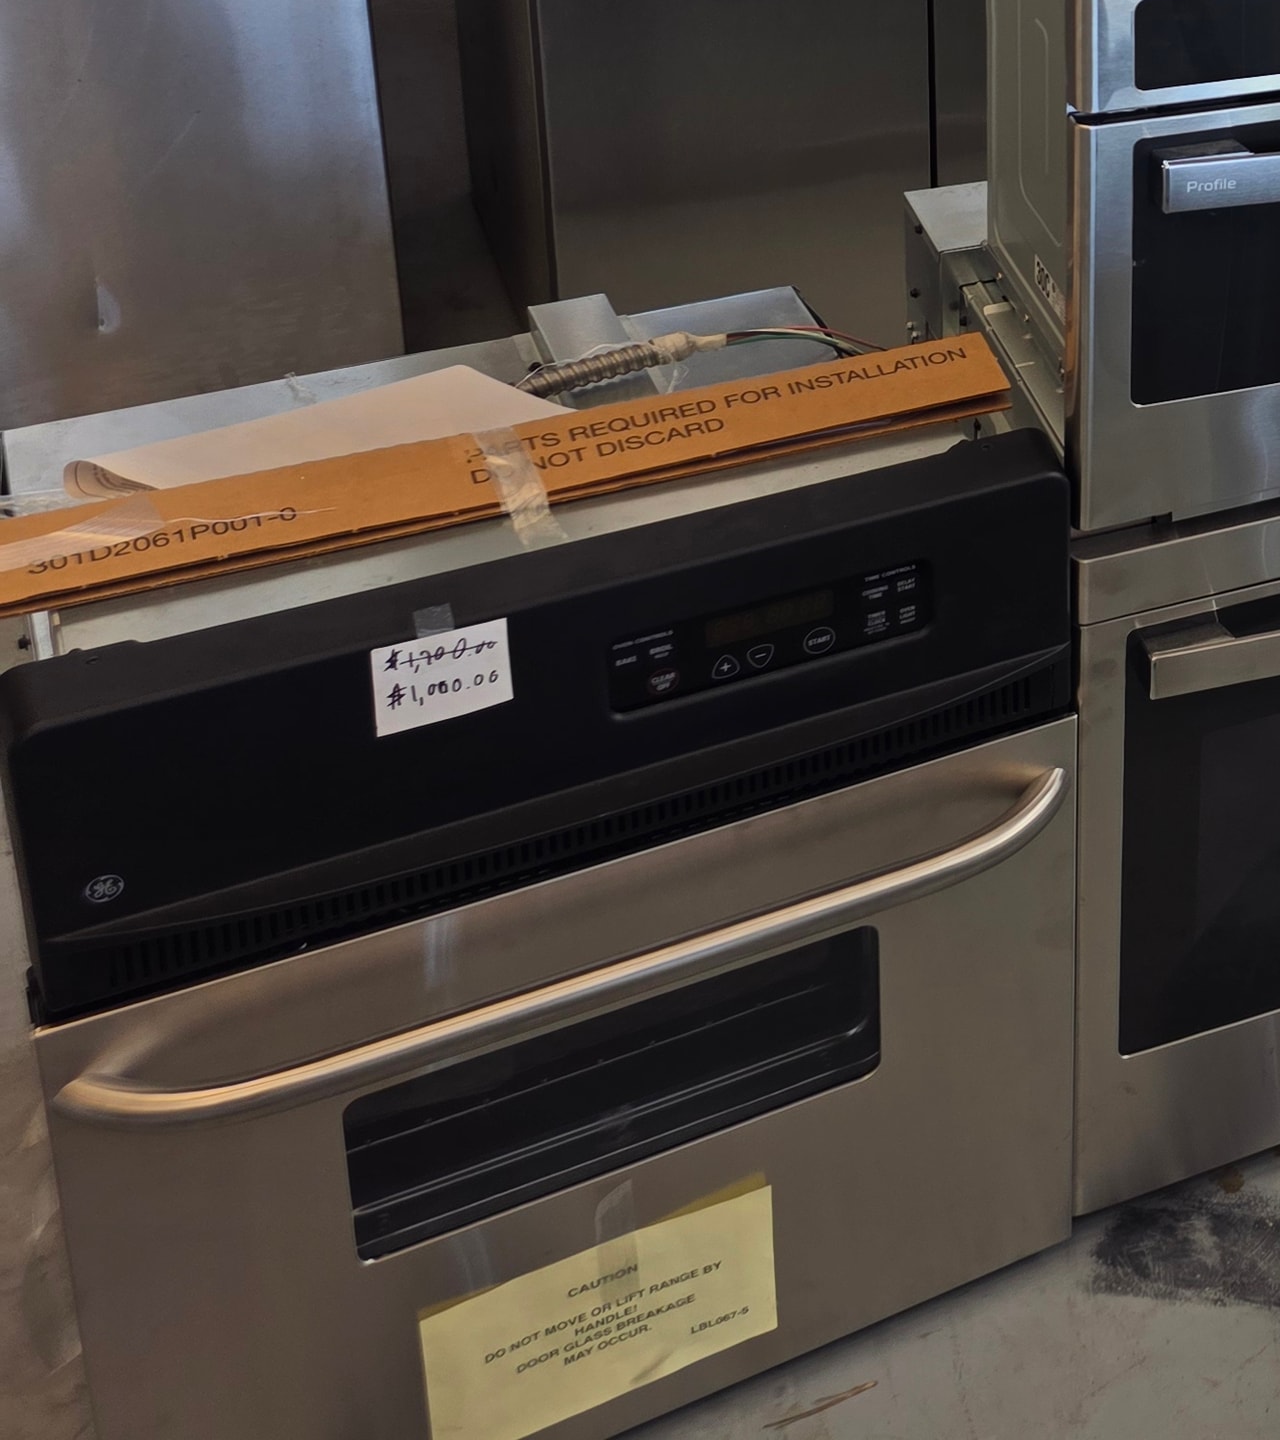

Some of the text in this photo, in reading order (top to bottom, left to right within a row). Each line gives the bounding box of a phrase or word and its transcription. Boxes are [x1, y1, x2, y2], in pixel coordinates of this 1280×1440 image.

[1187, 178, 1237, 193] Profile
[569, 398, 717, 443] REQUIRED
[723, 385, 783, 412] FOR
[787, 346, 968, 396] INSTALLATION
[533, 417, 725, 470] NOT DISCARD
[27, 507, 297, 576] 301D2061P001-0
[807, 634, 832, 646] START
[567, 1262, 639, 1298] CAUTION
[484, 1260, 722, 1364] DO NOT MOVE OR LIFT RANGE BY
[516, 1293, 697, 1375] DOOR GLASS BREAKAGE
[574, 1304, 638, 1338] HANDLE!
[563, 1324, 652, 1367] MAY OCCUR.
